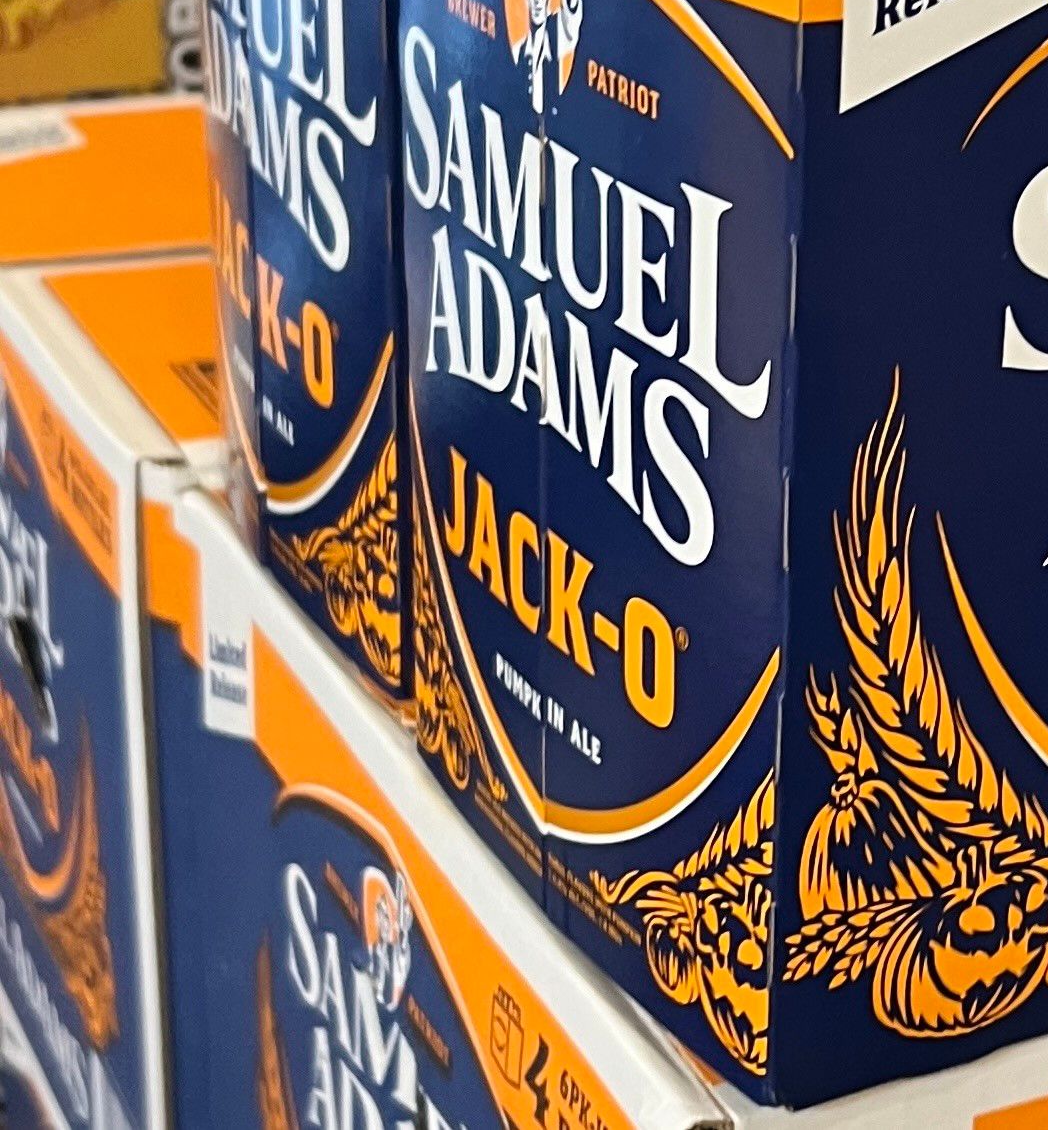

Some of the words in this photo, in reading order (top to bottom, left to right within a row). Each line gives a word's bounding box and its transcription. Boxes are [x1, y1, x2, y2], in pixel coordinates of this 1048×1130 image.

[403, 24, 773, 420] SAMUEL
[586, 59, 661, 121] PATRIOT
[425, 224, 715, 567] ADAMS
[443, 445, 677, 729] JACK-O
[570, 720, 603, 766] ALE
